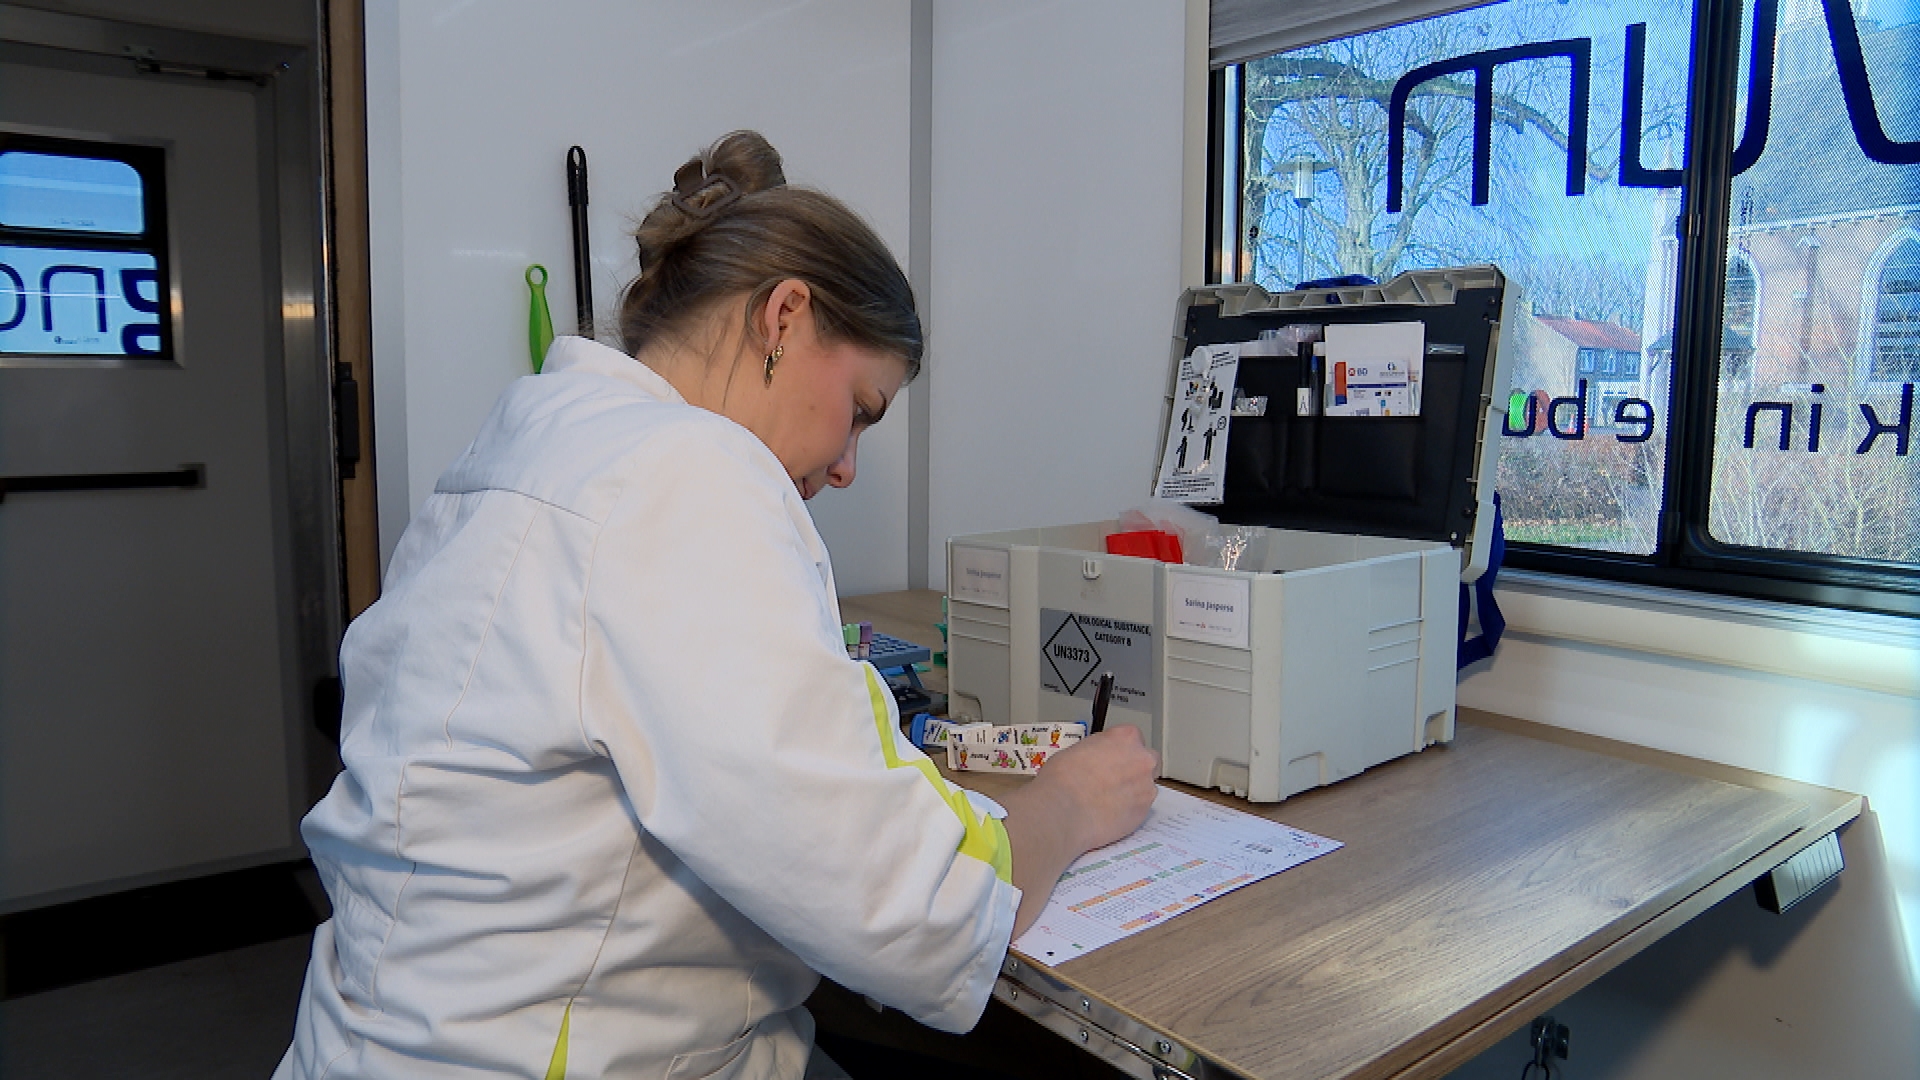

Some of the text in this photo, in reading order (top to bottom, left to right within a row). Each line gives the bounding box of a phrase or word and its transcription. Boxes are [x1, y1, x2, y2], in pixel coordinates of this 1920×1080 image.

[1357, 367, 1368, 377] BD
[1078, 615, 1151, 636] BIOLOGICAL SUBSTANCE,
[1094, 632, 1132, 646] CATEGORY B
[1053, 643, 1090, 663] UN3373
